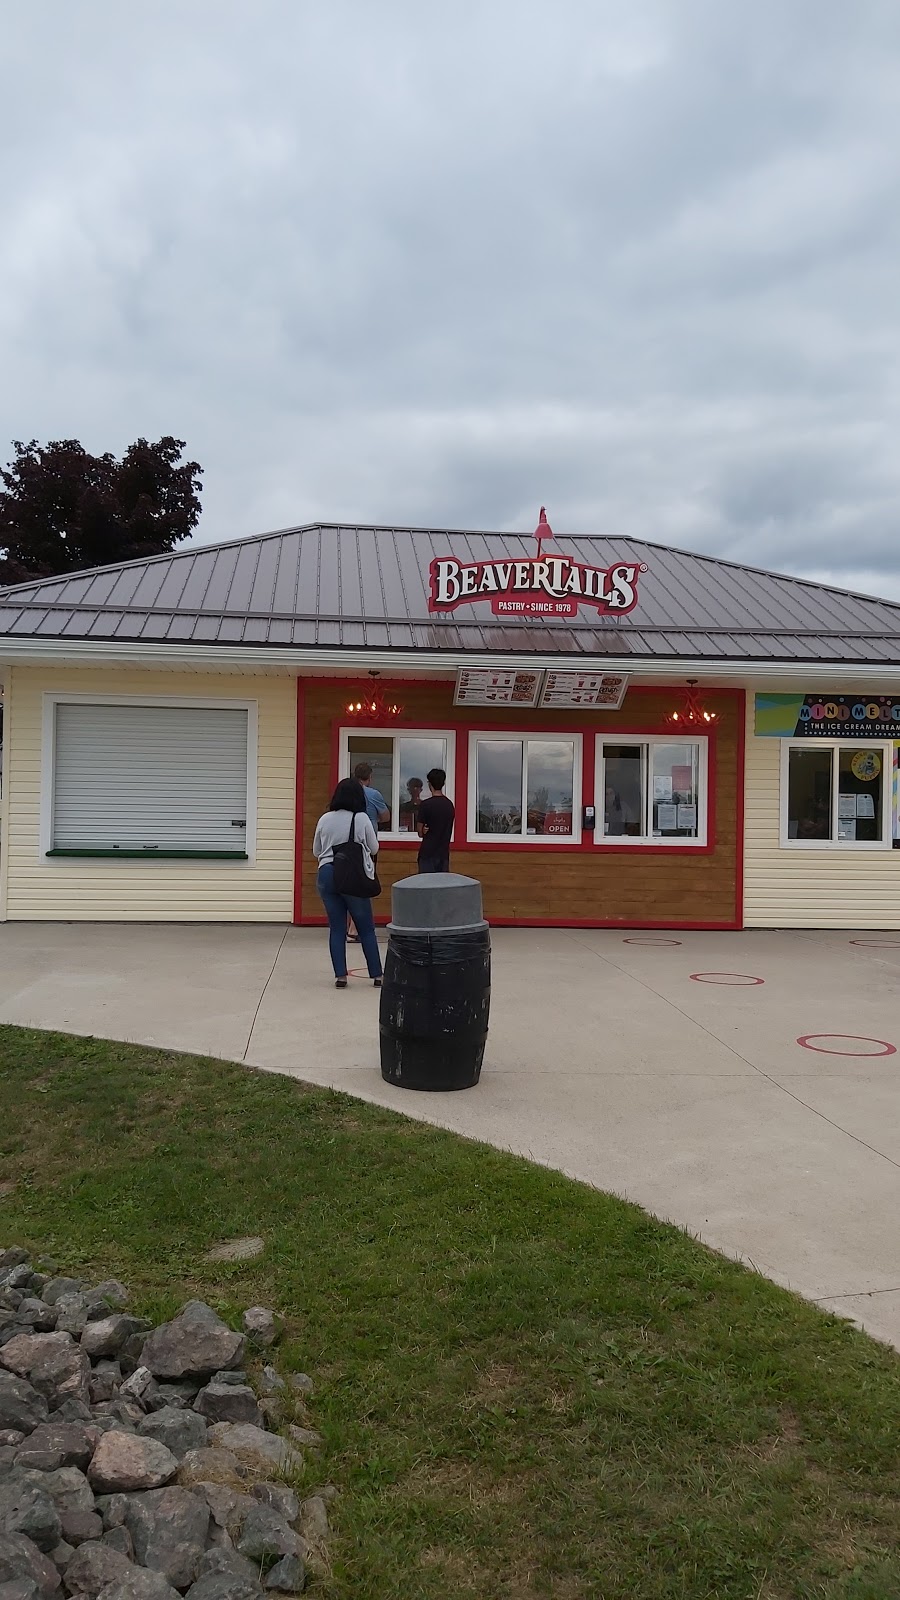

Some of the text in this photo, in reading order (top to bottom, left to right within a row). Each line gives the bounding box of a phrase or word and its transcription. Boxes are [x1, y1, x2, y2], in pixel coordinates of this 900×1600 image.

[498, 601, 571, 612] PASTRY SINCE 1978
[800, 705, 845, 718] MINI
[844, 723, 872, 731] CREAM
